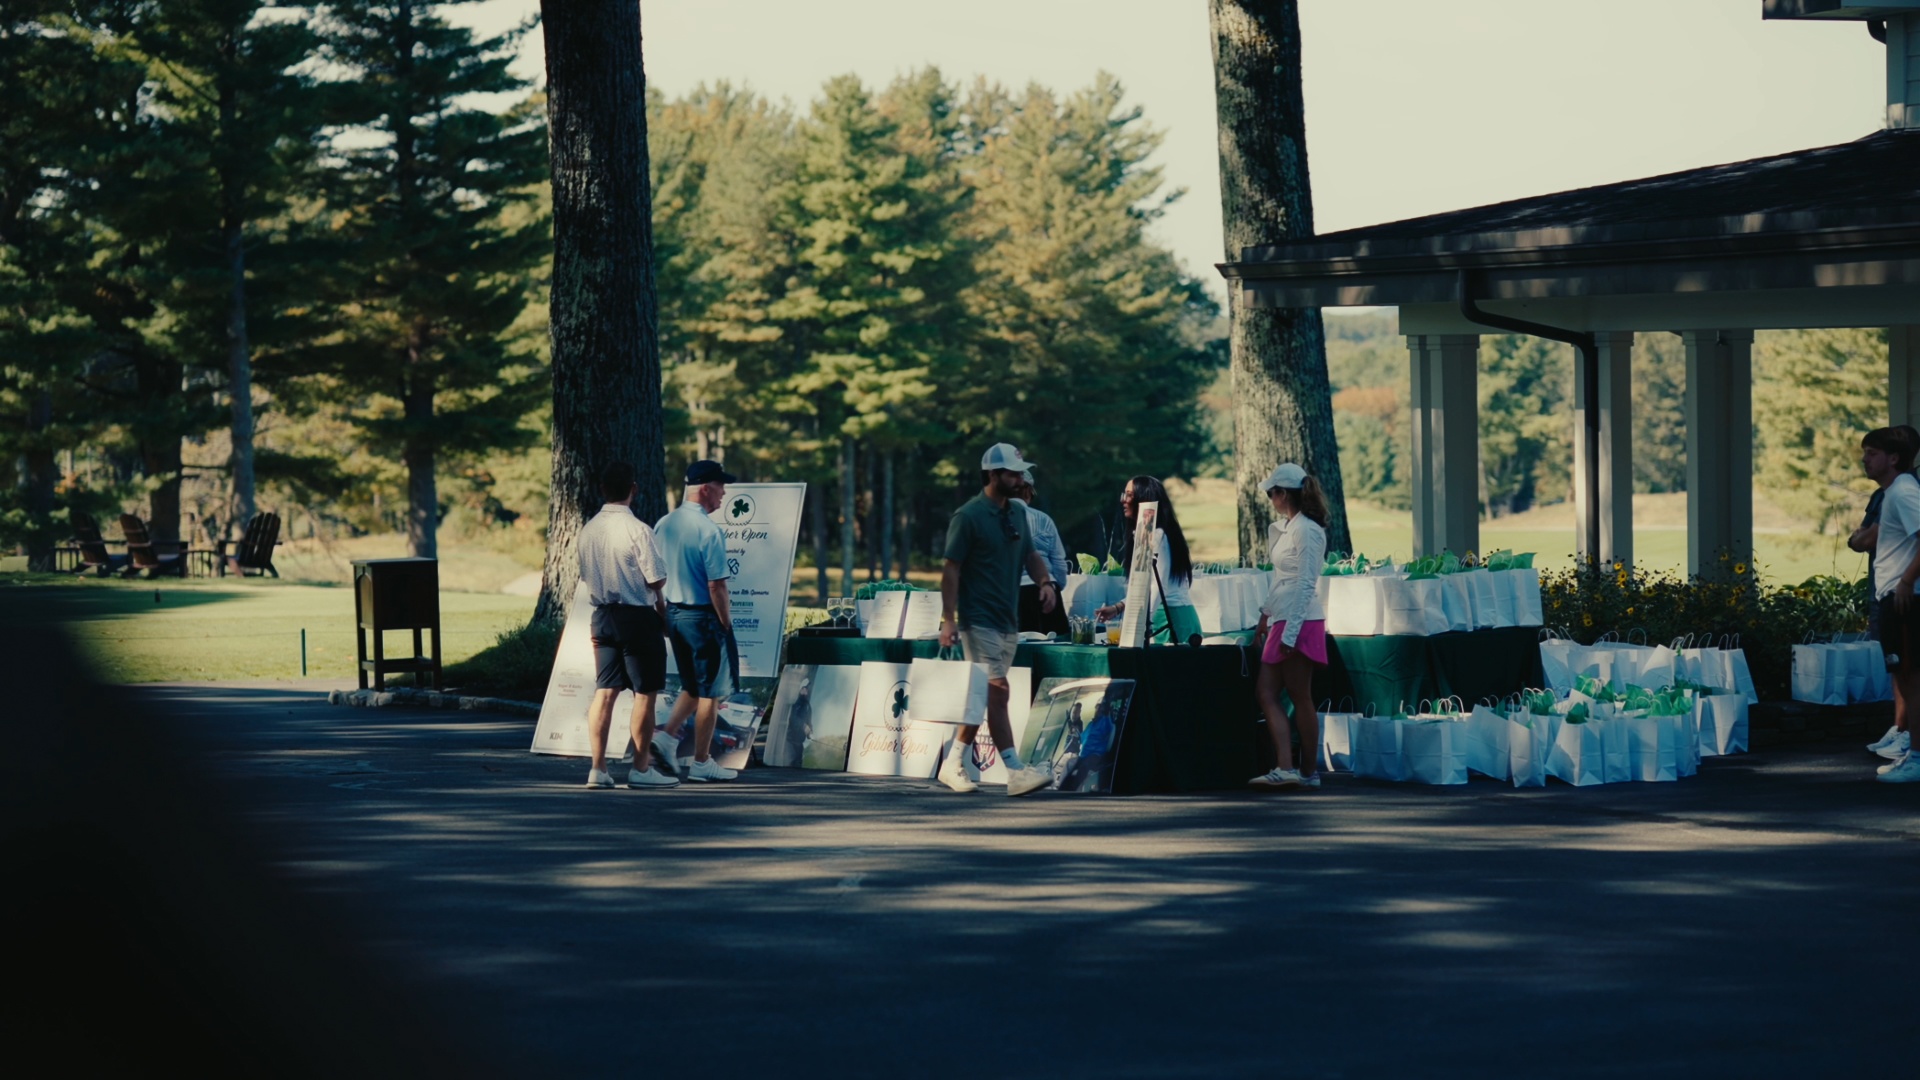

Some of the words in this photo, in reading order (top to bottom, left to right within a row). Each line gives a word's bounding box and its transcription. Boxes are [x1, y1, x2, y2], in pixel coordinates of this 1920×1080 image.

[741, 527, 768, 543] Open
[860, 732, 898, 757] Gibber
[900, 736, 929, 760] Open
